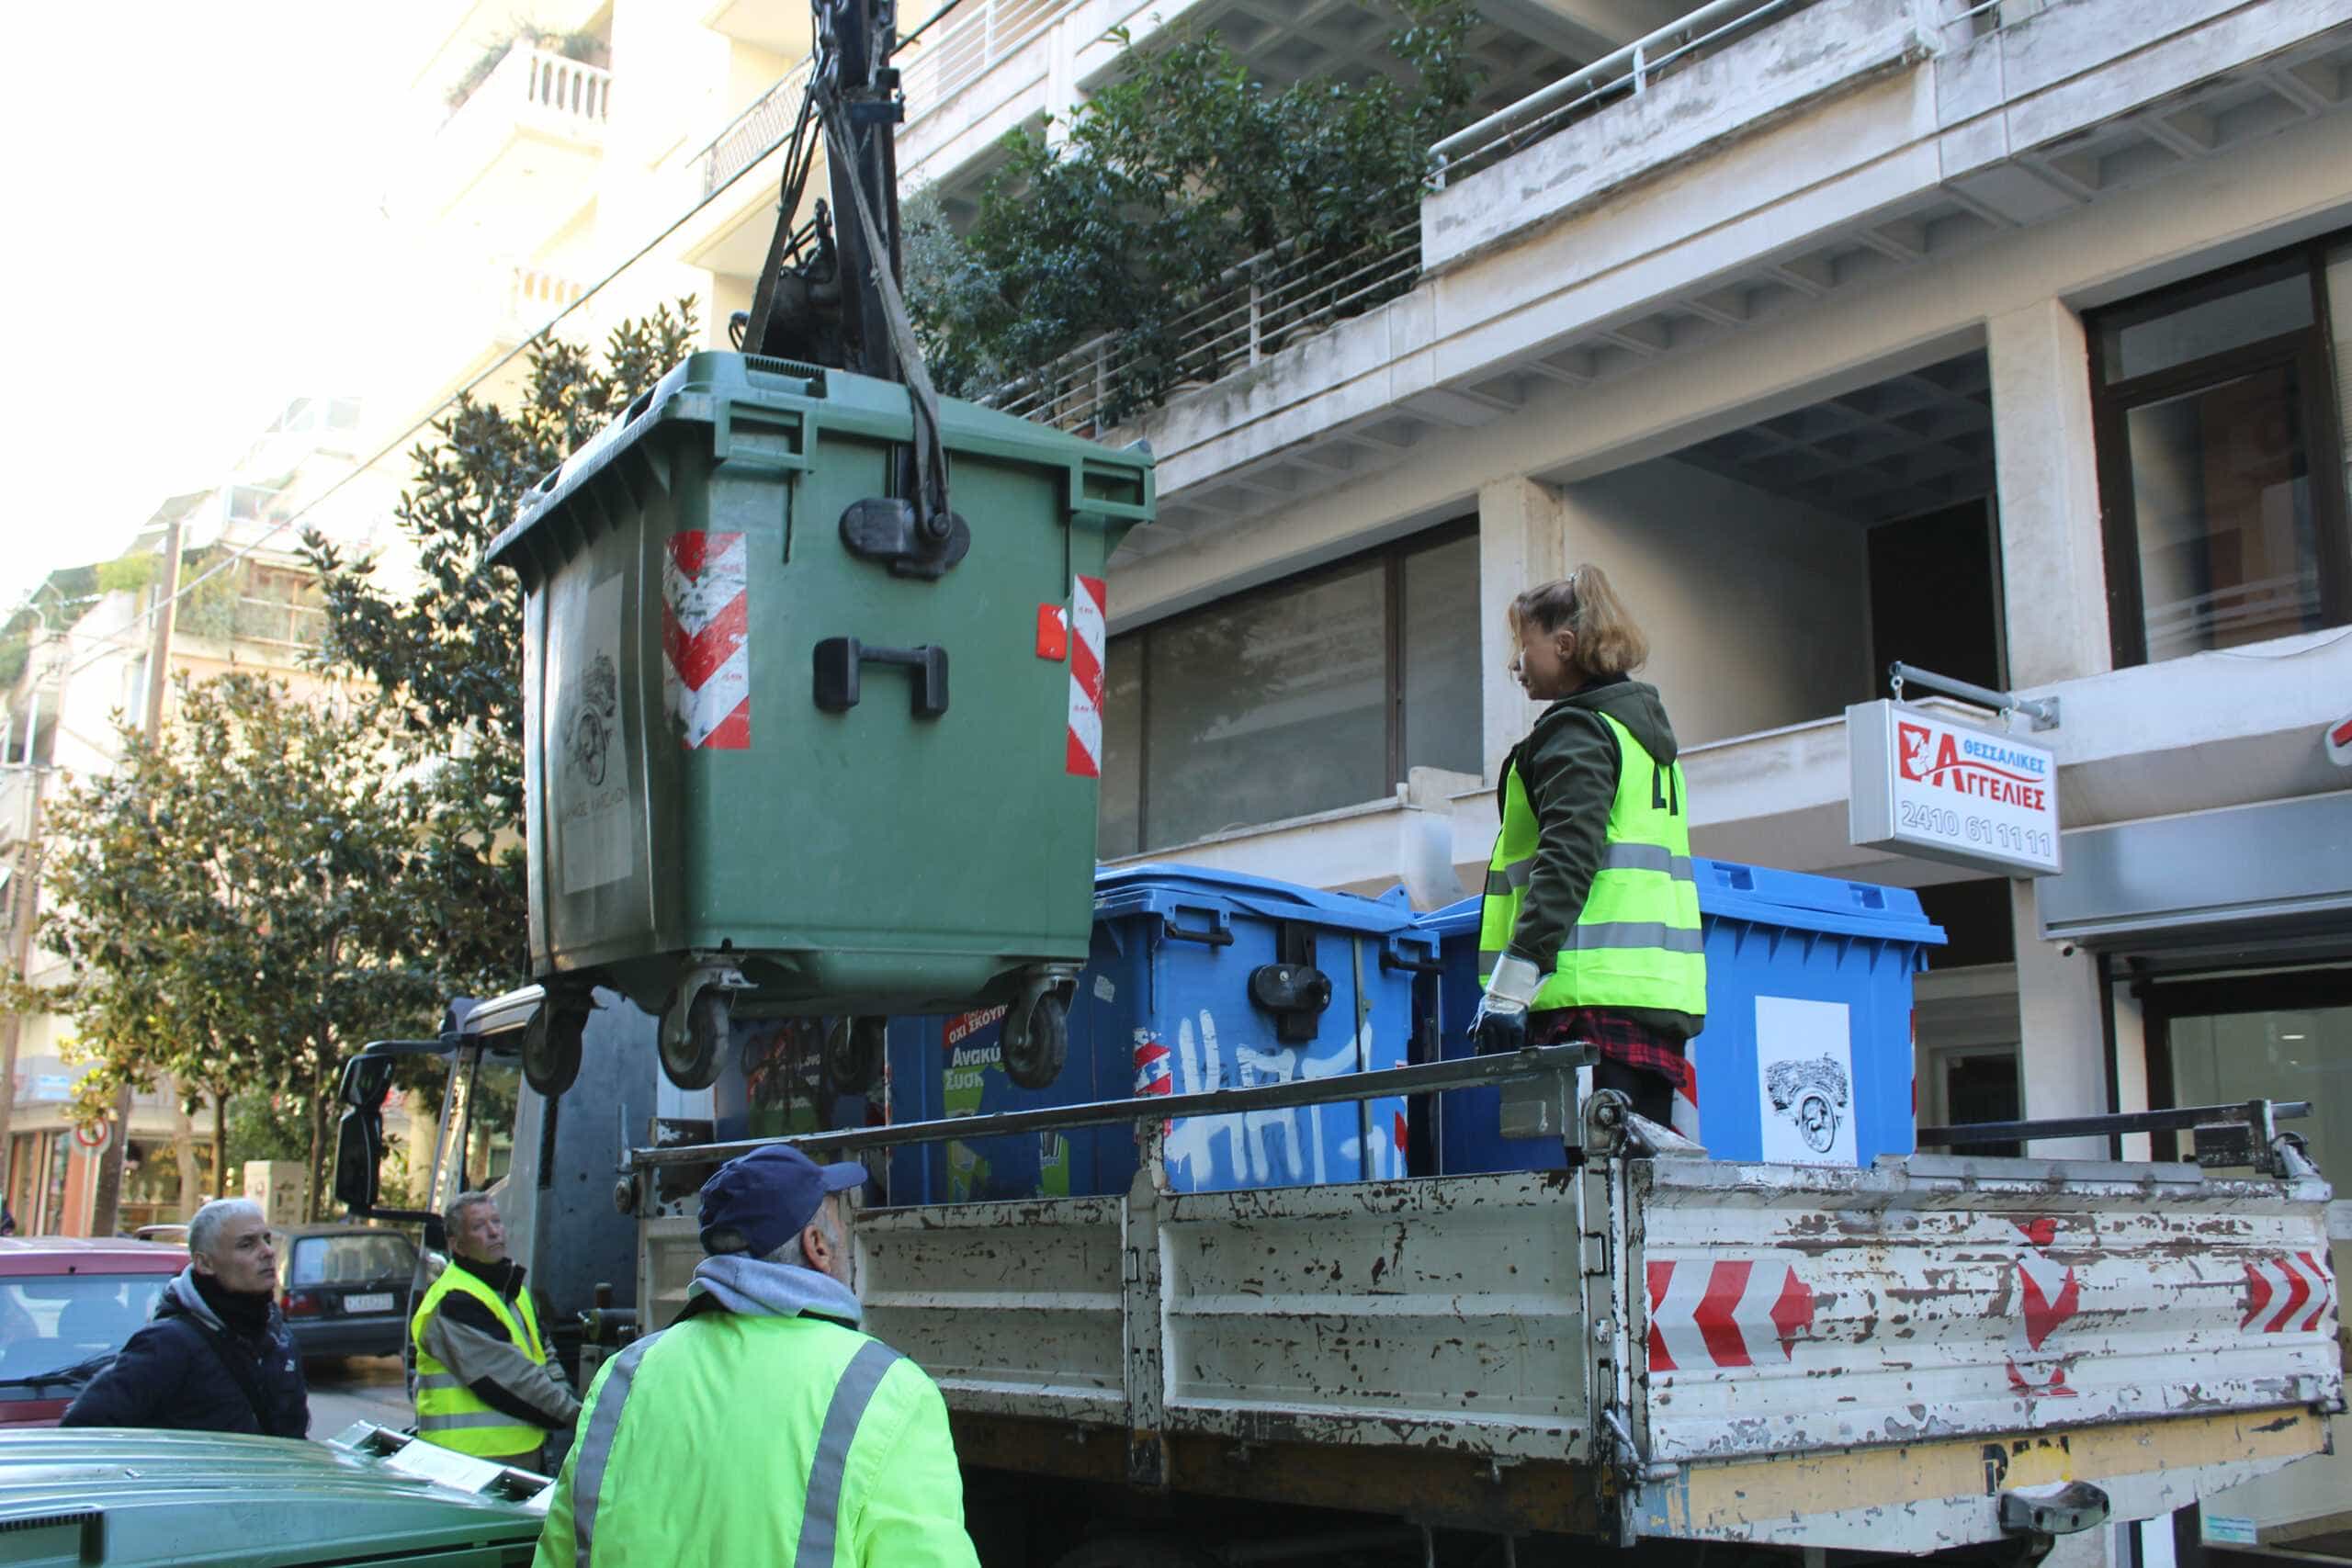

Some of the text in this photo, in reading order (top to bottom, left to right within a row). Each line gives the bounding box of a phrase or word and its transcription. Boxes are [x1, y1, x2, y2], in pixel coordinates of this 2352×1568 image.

[1932, 733, 2046, 811] ΑΓΓΕΛΙΕΣ
[1963, 739, 2045, 773] ΘΕΣΣΑΛΙΚΕΣ
[1901, 800, 1959, 836] 2410
[949, 1023, 967, 1043] ΟΧΙ
[969, 1005, 1008, 1033] ΣΚΟΥΠ
